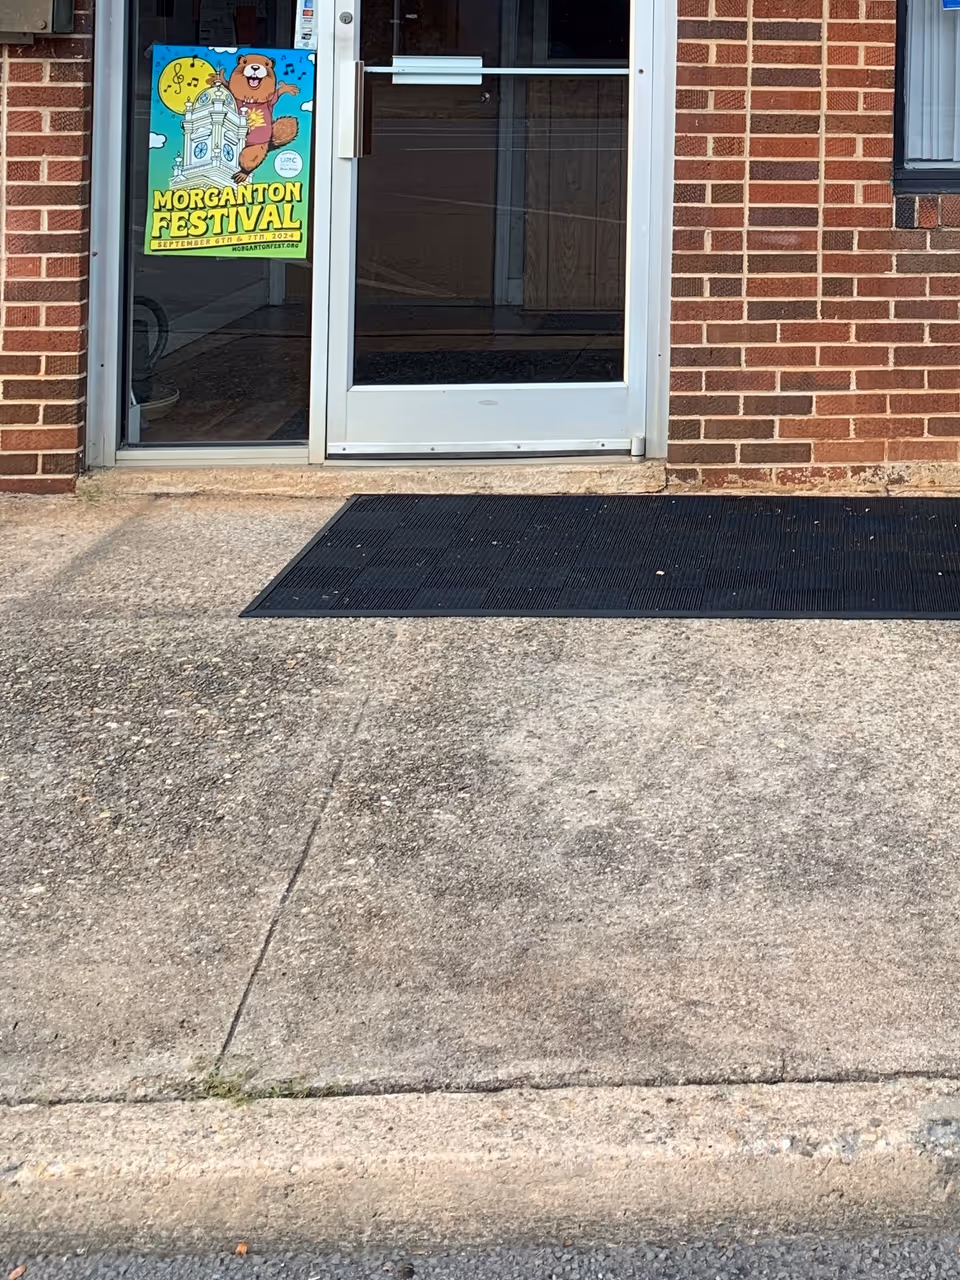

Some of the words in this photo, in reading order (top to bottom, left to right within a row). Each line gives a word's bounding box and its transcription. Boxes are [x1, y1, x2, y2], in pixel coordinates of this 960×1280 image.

[153, 182, 302, 209] MORGANTON
[151, 203, 302, 239] FESTIVAL
[157, 238, 211, 248] SEPTEMBER
[215, 236, 233, 244] 6TH
[272, 232, 295, 240] 2024
